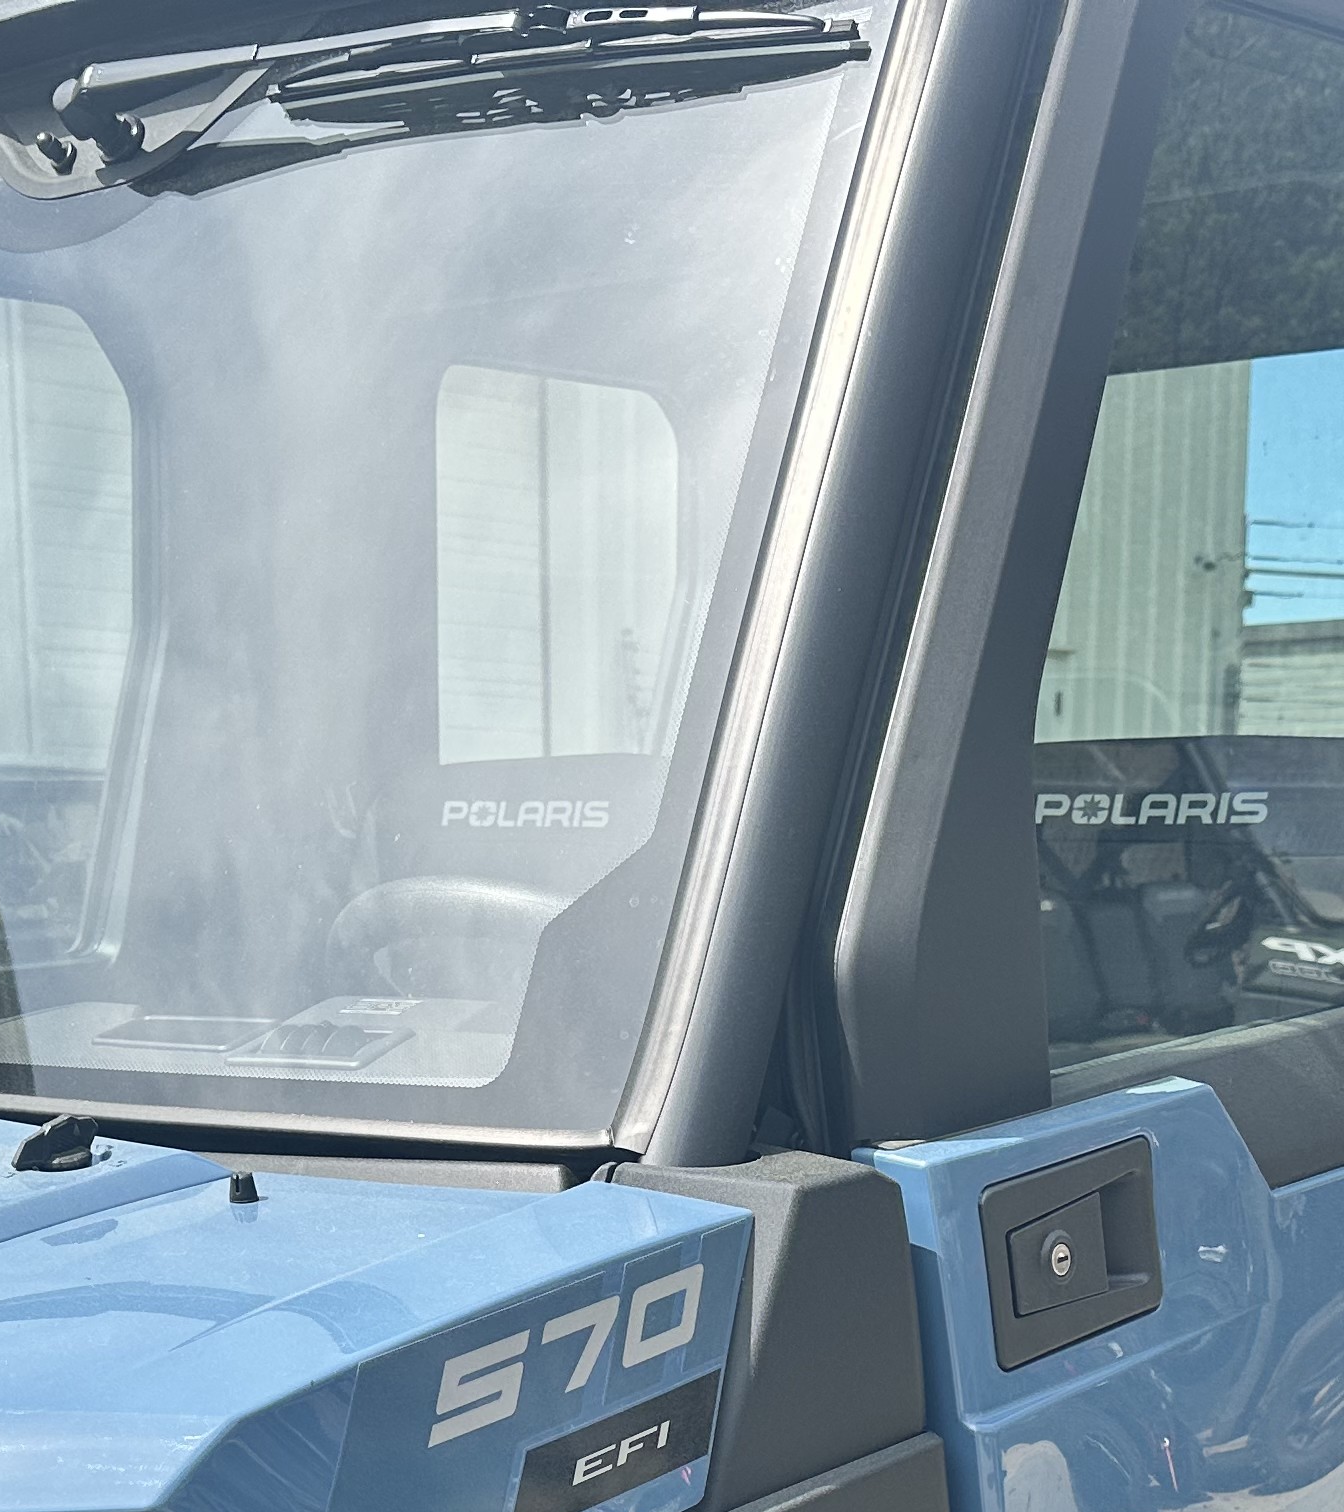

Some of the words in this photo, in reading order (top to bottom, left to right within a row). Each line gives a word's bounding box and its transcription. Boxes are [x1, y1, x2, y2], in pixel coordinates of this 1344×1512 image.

[441, 799, 609, 828] POLARIS
[1035, 791, 1269, 825] POLARIS
[428, 1264, 704, 1448] 570
[572, 1420, 670, 1486] EFI
